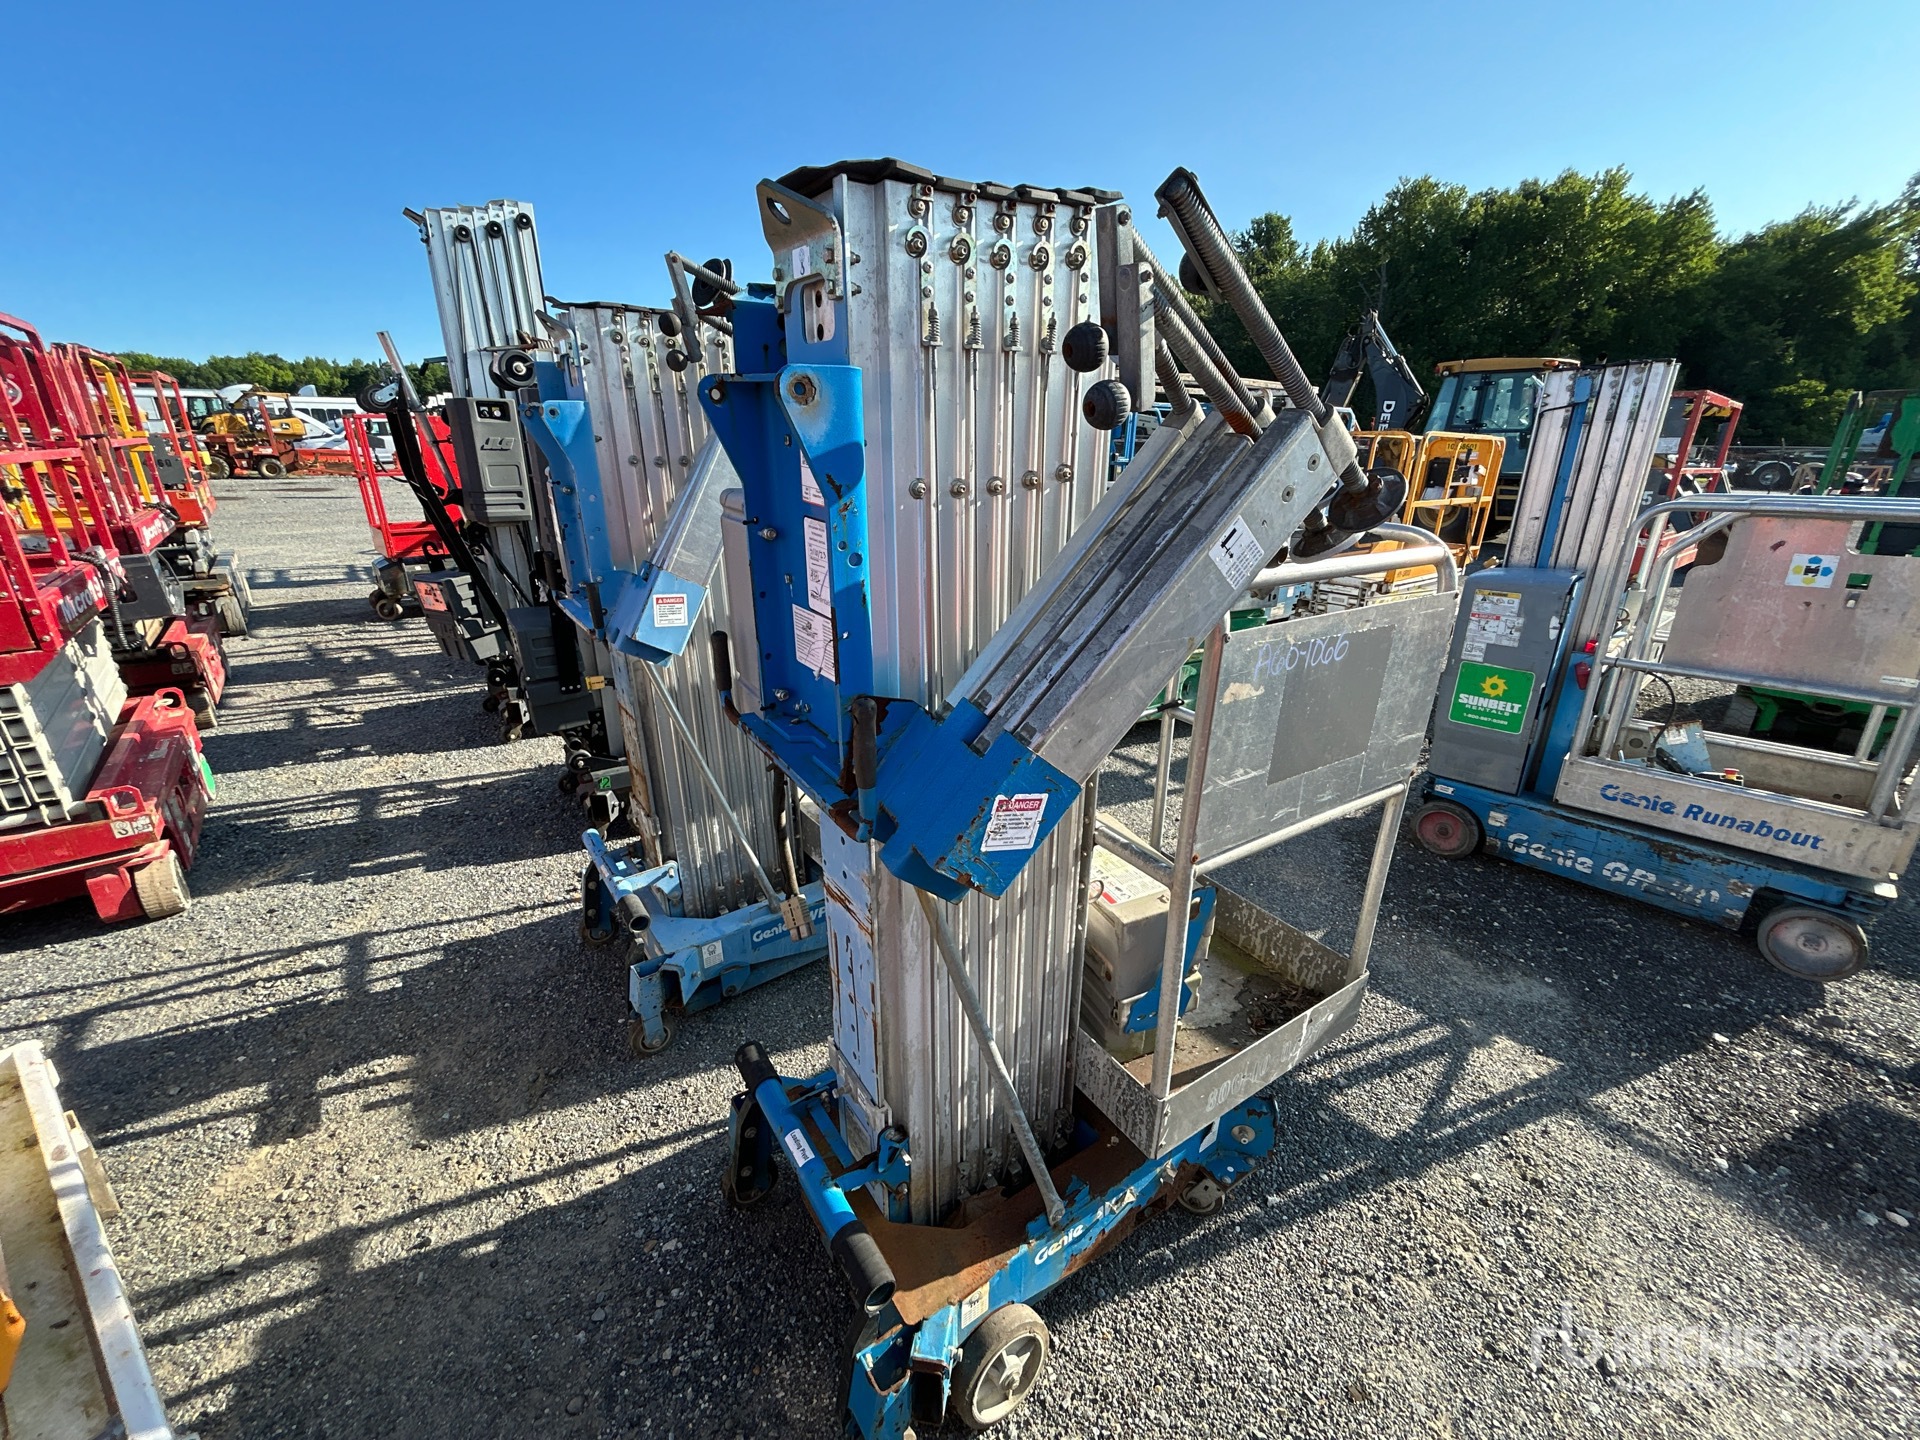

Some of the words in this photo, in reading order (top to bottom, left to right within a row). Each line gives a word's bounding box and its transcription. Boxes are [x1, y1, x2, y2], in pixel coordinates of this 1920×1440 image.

[480, 437, 515, 451] JLG
[1458, 693, 1522, 714] SUNBELT
[1465, 704, 1510, 717] RENTALS
[1009, 800, 1040, 809] DANGER
[1600, 784, 1677, 815] Genie
[1683, 804, 1825, 850] Runabout
[1507, 832, 1593, 875] Genie
[790, 1131, 803, 1151] Loading
[1034, 1224, 1085, 1265] Genie
